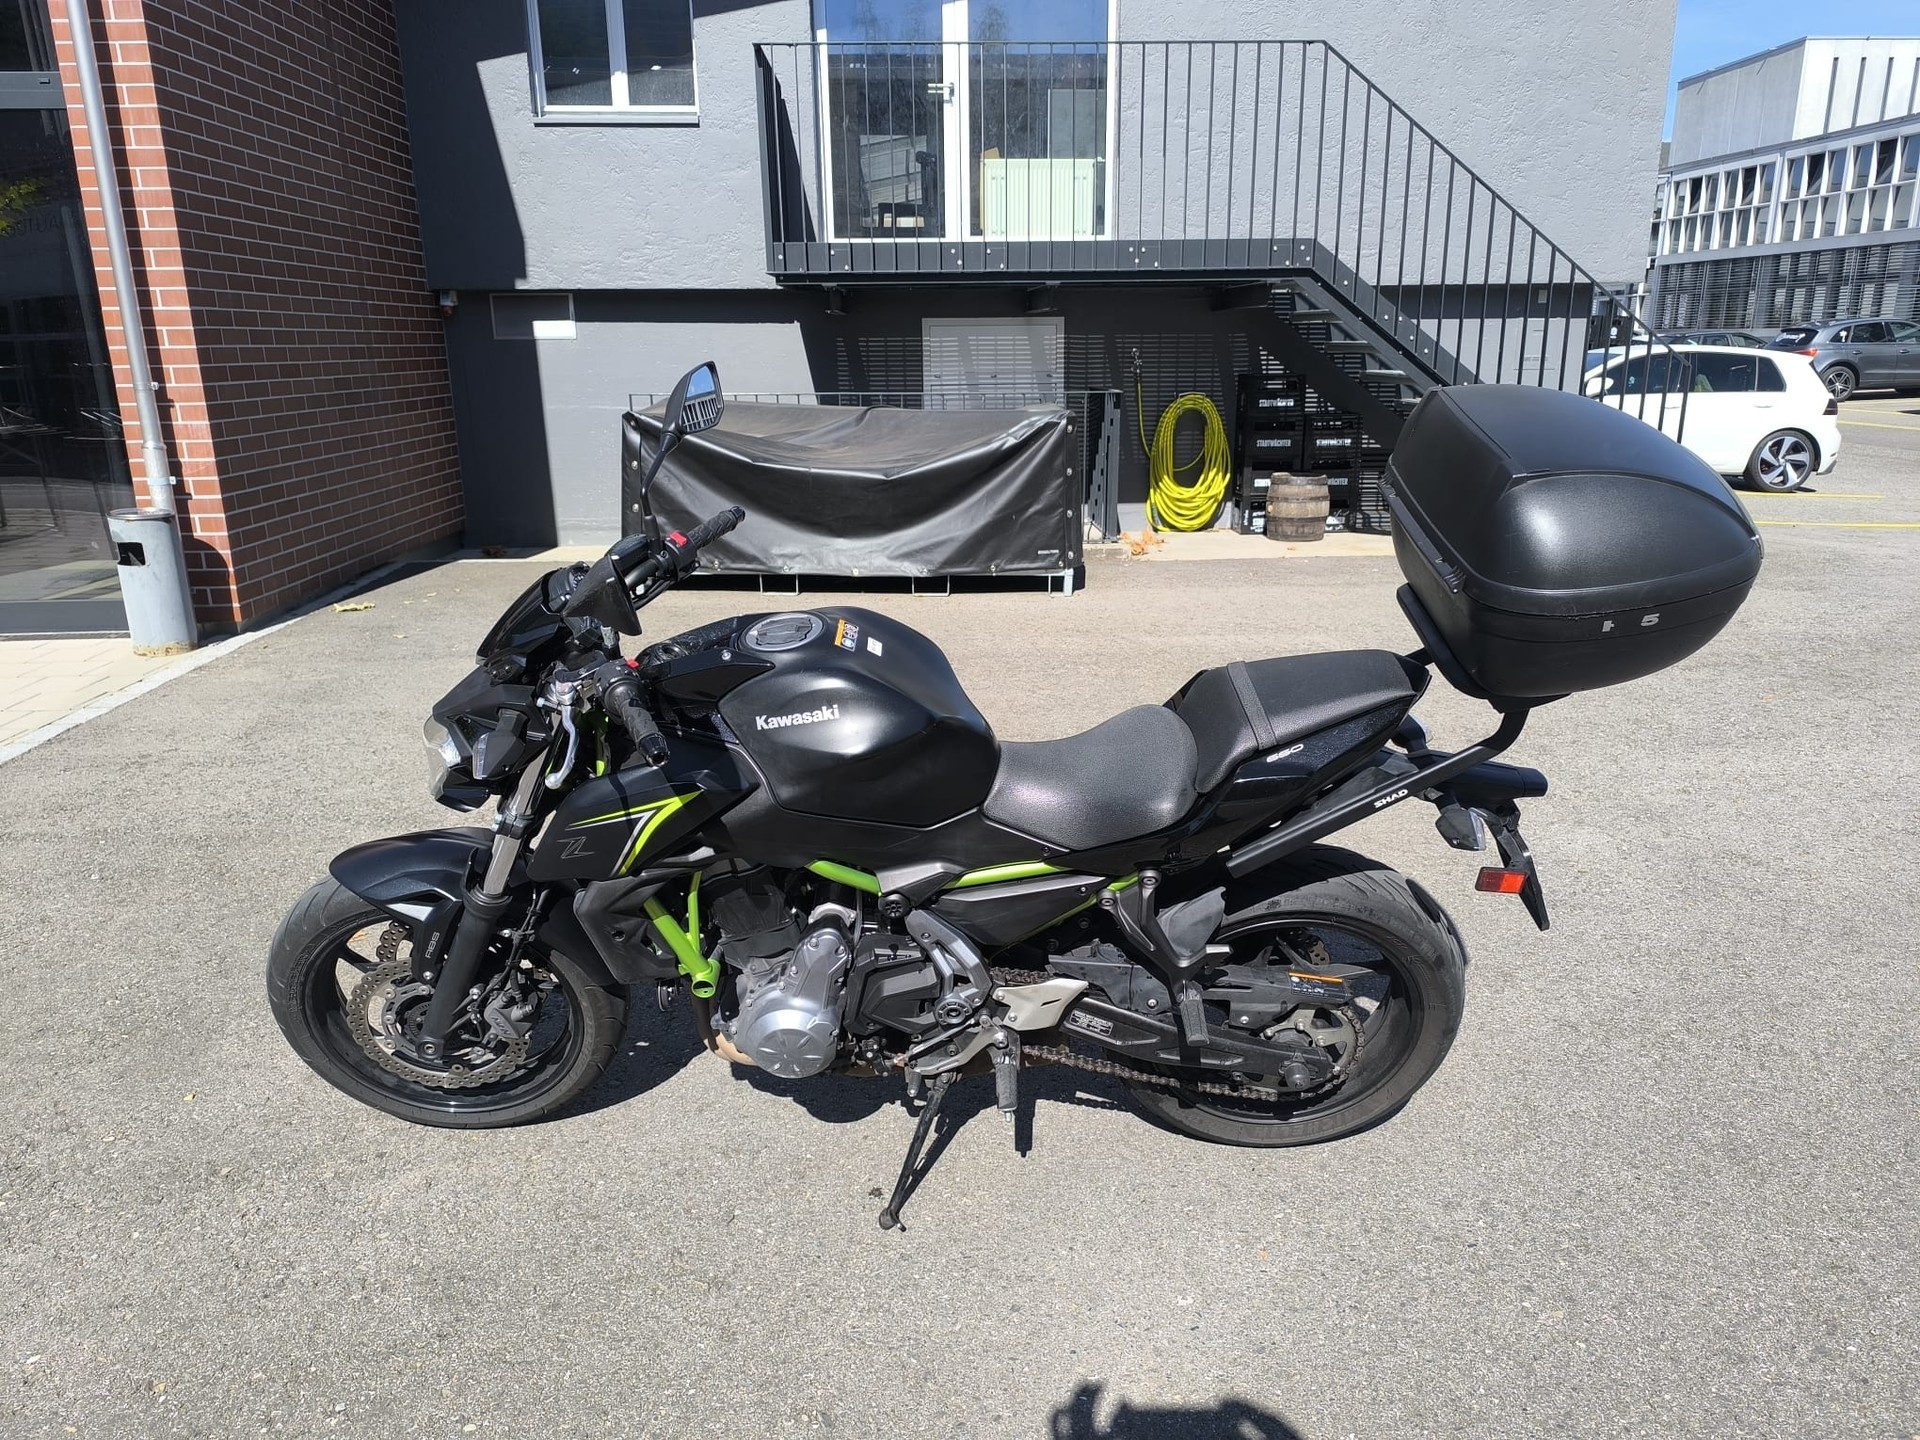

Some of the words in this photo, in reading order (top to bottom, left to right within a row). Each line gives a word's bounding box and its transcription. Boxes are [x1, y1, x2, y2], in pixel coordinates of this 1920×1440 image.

[755, 704, 840, 731] Kawasaki
[1373, 789, 1409, 808] SHAD
[424, 931, 440, 959] ABS
